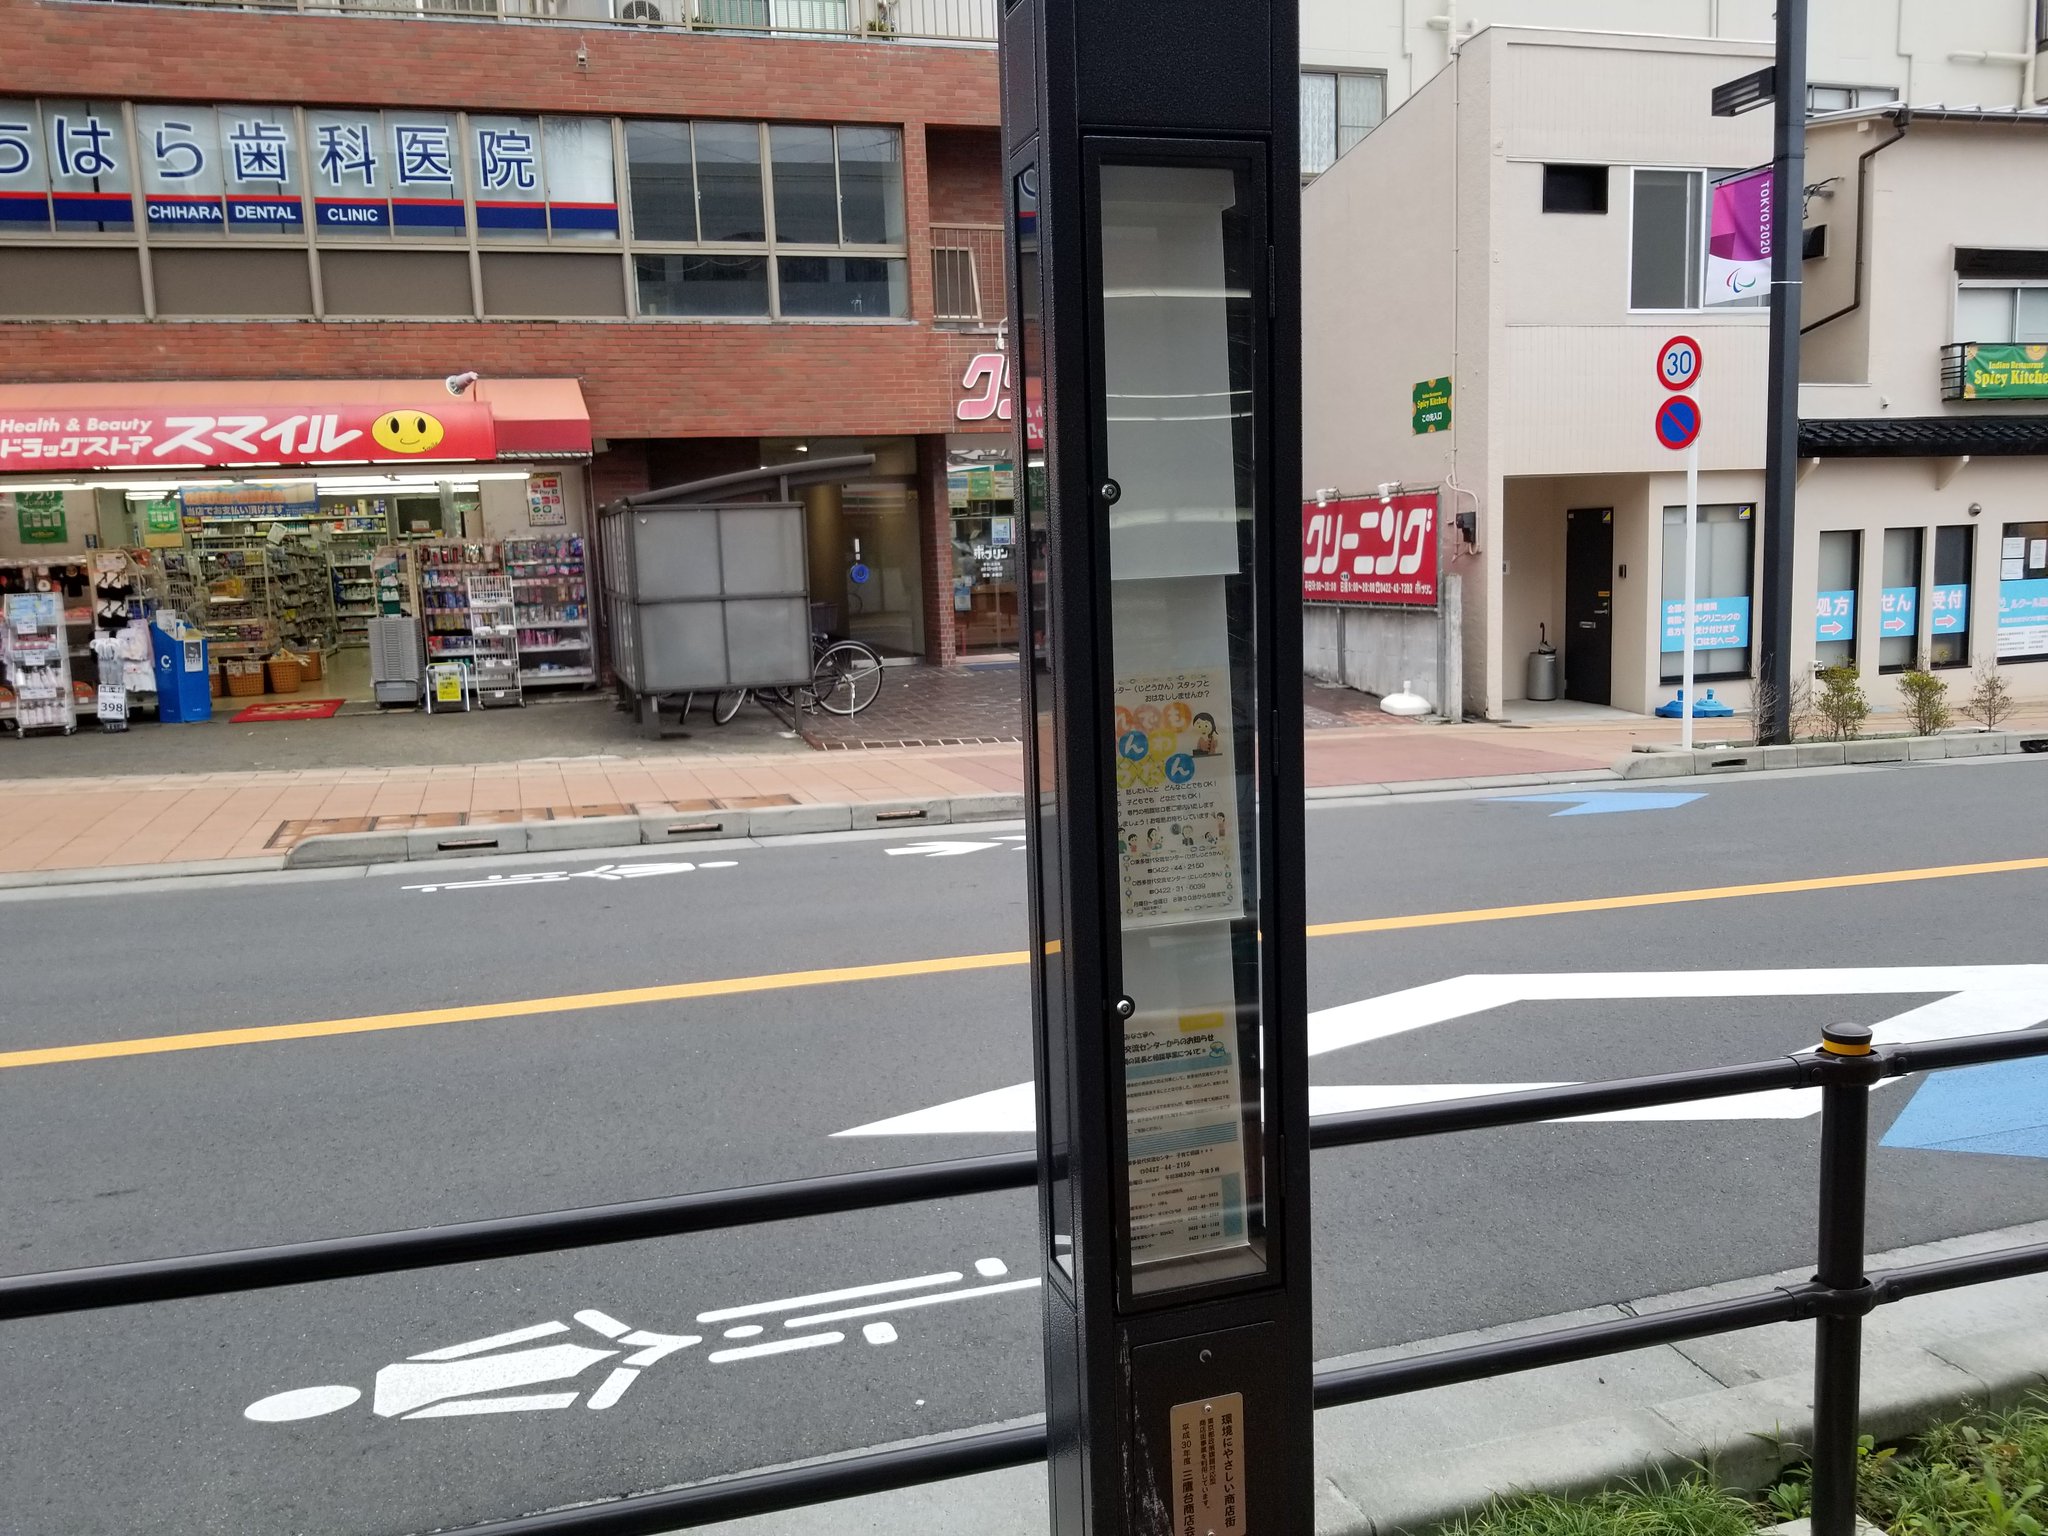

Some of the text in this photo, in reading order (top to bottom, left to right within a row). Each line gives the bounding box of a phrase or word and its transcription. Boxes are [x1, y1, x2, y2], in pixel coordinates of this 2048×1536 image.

[148, 205, 378, 222] CHIHARA DENTAL CLINIC
[1760, 181, 1771, 254] TOKYO 2020
[1667, 350, 1692, 376] 30
[1974, 369, 2008, 388] Spicy
[0, 417, 152, 434] Health & Beauty
[152, 414, 363, 457] スマイル
[0, 435, 153, 458] ドラッグストア
[1303, 505, 1433, 575] クリーニング
[1816, 590, 1963, 617] 処方 せん 受付
[100, 702, 123, 712] 398
[1221, 1413, 1236, 1528] 環境にやさしい商店街
